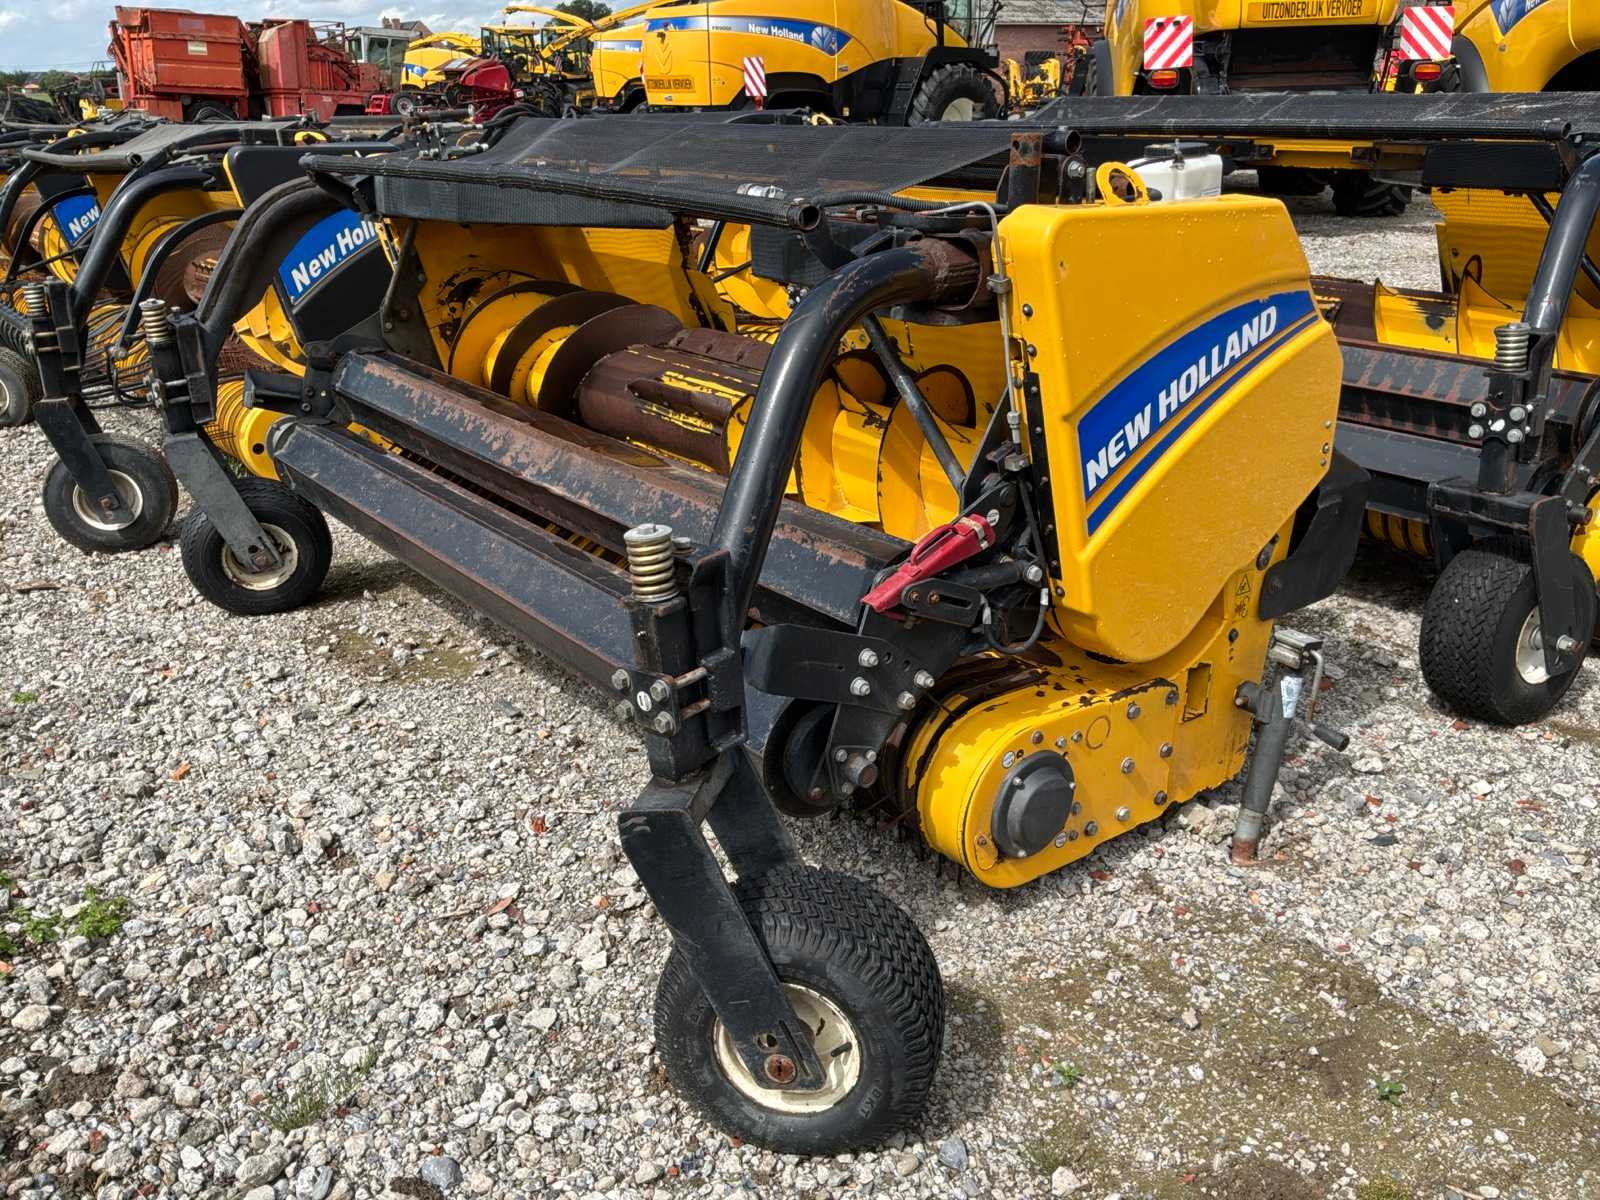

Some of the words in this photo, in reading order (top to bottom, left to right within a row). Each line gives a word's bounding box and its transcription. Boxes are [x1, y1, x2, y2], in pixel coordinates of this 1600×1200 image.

[1262, 1, 1323, 19] UITZONDERLIJK
[1326, 0, 1363, 17] VERVOER
[748, 23, 768, 35] New
[770, 25, 804, 42] Holland
[68, 205, 100, 238] New
[291, 244, 337, 293] New
[336, 220, 376, 256] Holl
[1086, 402, 1151, 492] NEW
[1158, 305, 1277, 422] HOLLAND
